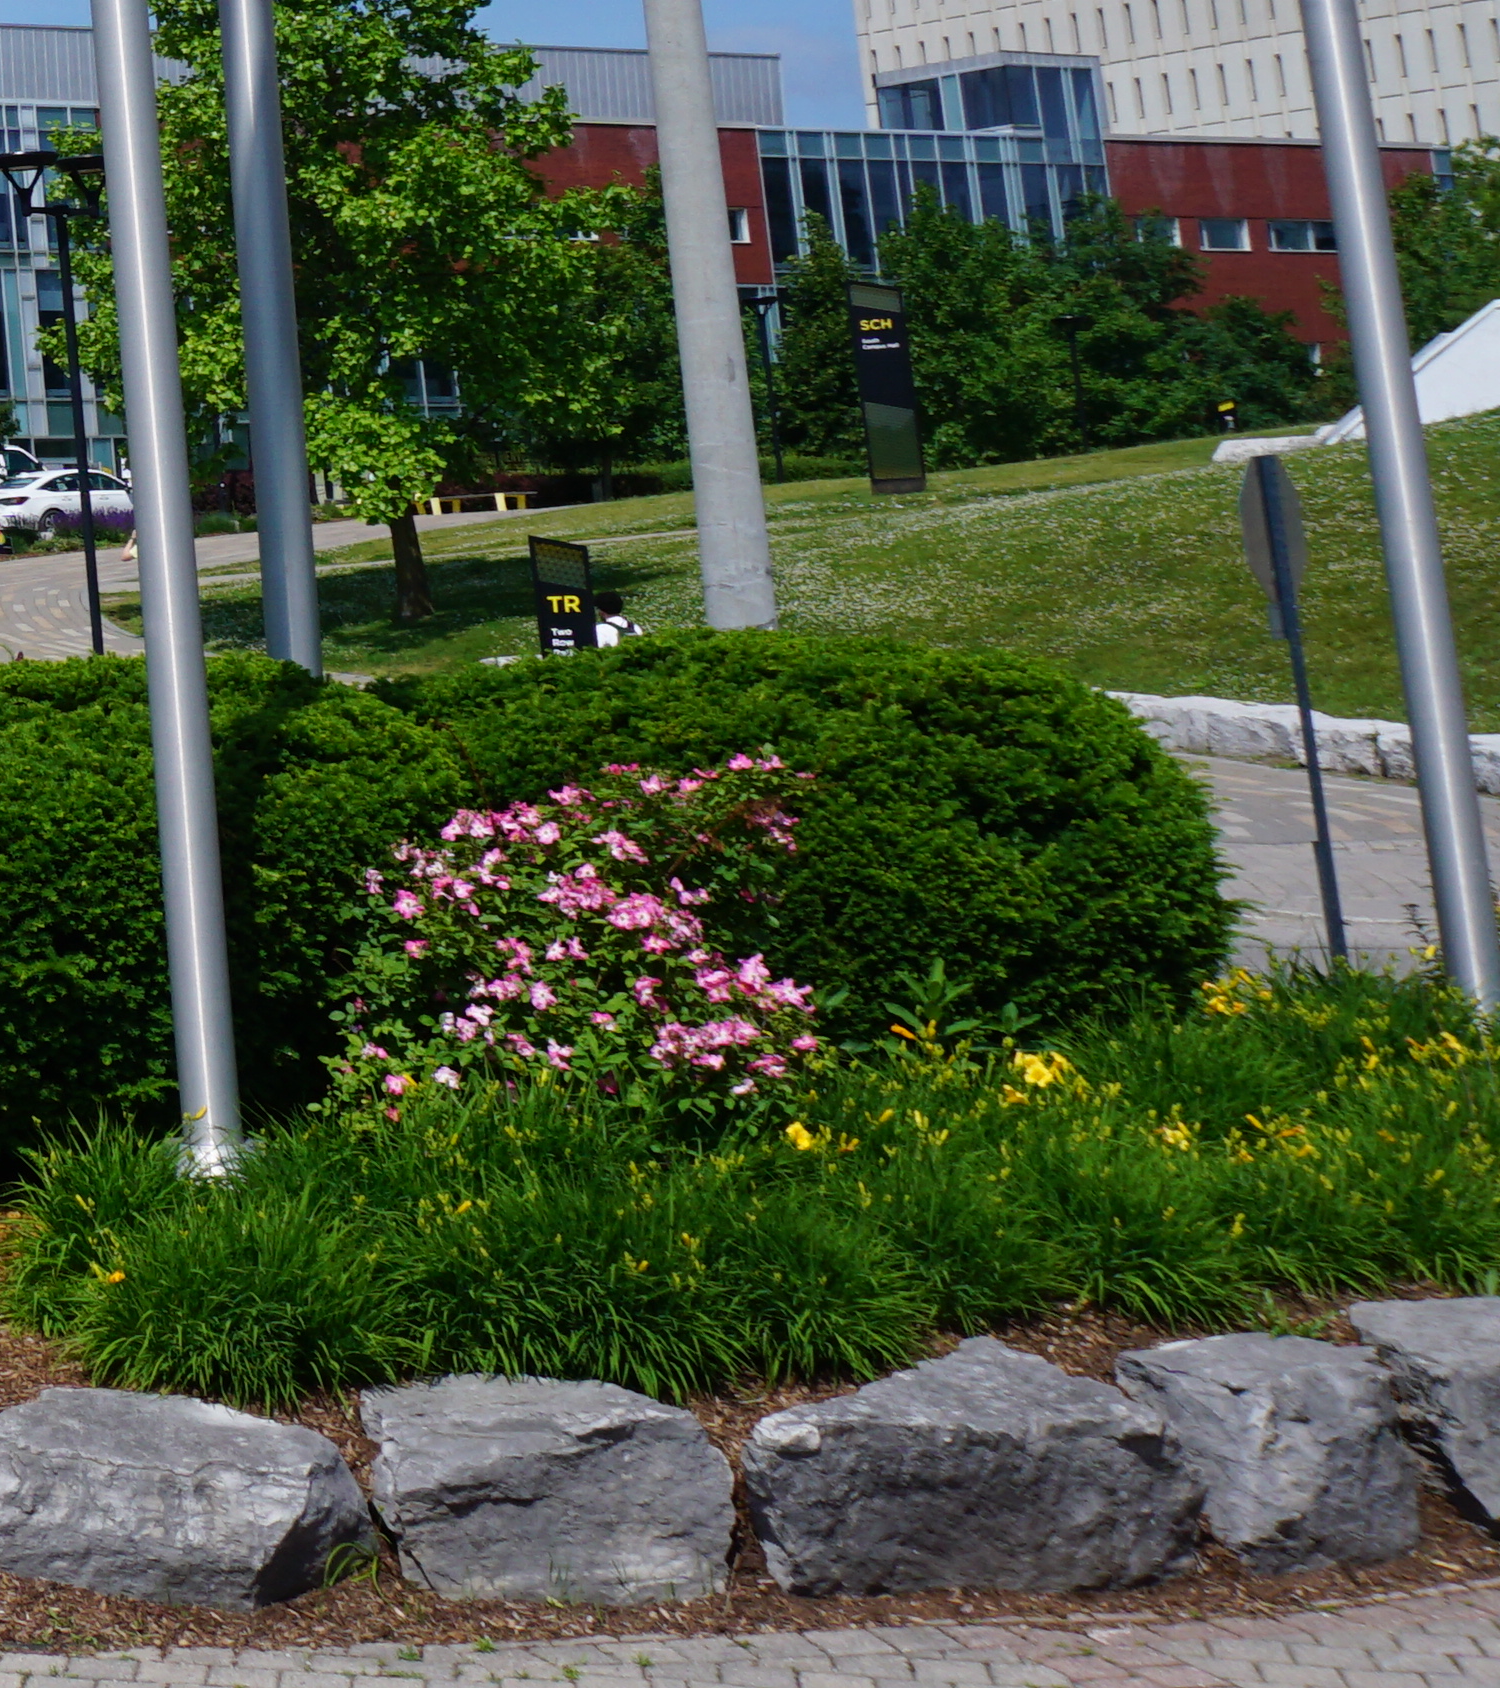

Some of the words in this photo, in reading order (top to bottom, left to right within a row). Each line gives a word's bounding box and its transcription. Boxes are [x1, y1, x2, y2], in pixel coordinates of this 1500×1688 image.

[859, 318, 893, 331] SCH
[546, 595, 582, 613] TR
[550, 627, 574, 637] Two
[551, 638, 575, 647] Row
